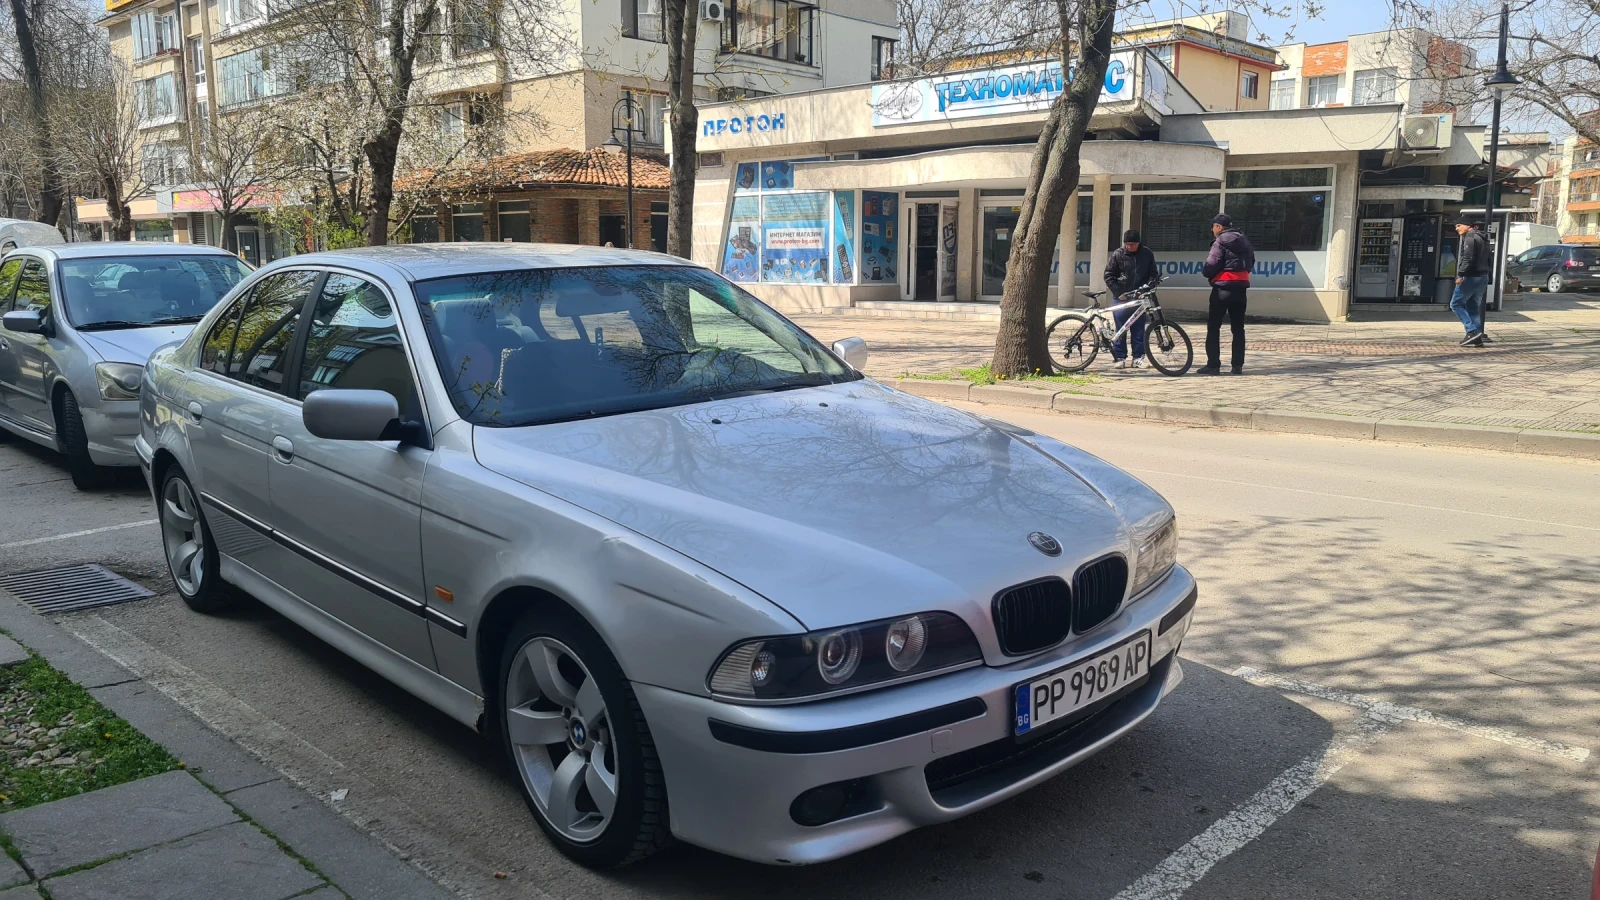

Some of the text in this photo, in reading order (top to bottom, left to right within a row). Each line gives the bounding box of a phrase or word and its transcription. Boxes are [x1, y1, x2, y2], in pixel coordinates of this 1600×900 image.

[935, 59, 1125, 112] ТЕХНОМАТС
[703, 113, 785, 136] ПРОТОН
[1034, 678, 1065, 721] PP
[1123, 641, 1146, 681] AP
[1017, 713, 1029, 726] BG
